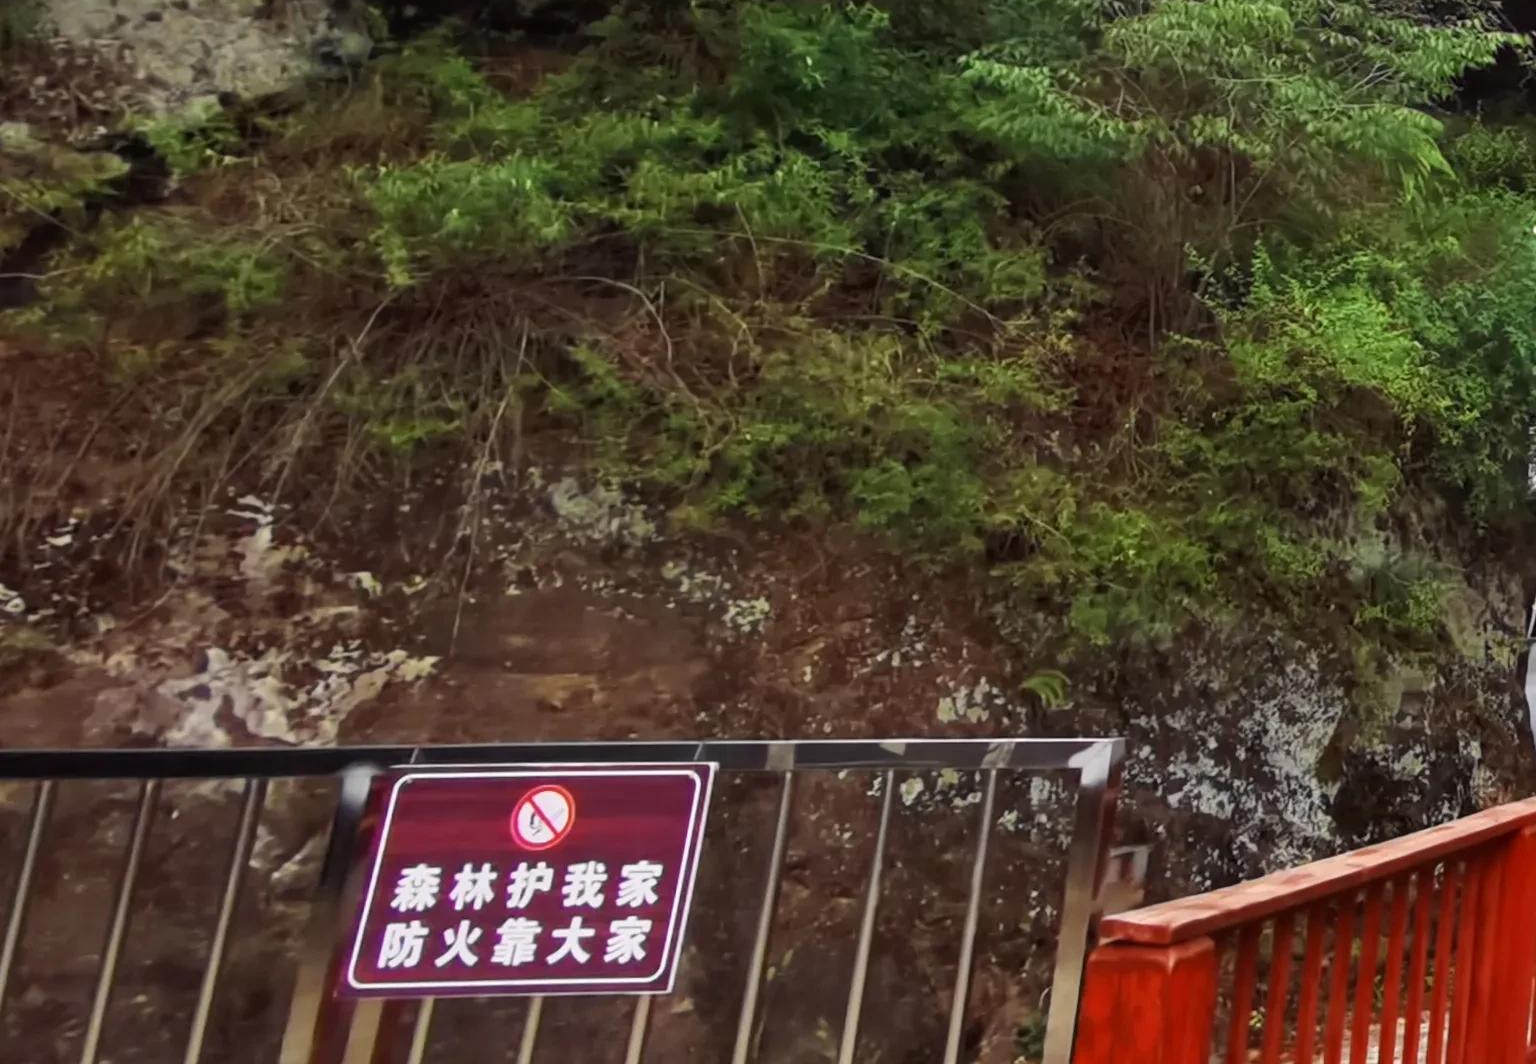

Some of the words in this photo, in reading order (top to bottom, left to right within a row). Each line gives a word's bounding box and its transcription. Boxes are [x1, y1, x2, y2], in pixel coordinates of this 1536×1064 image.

[390, 860, 664, 912] 森林护我家
[377, 915, 653, 969] 防火靠大家
